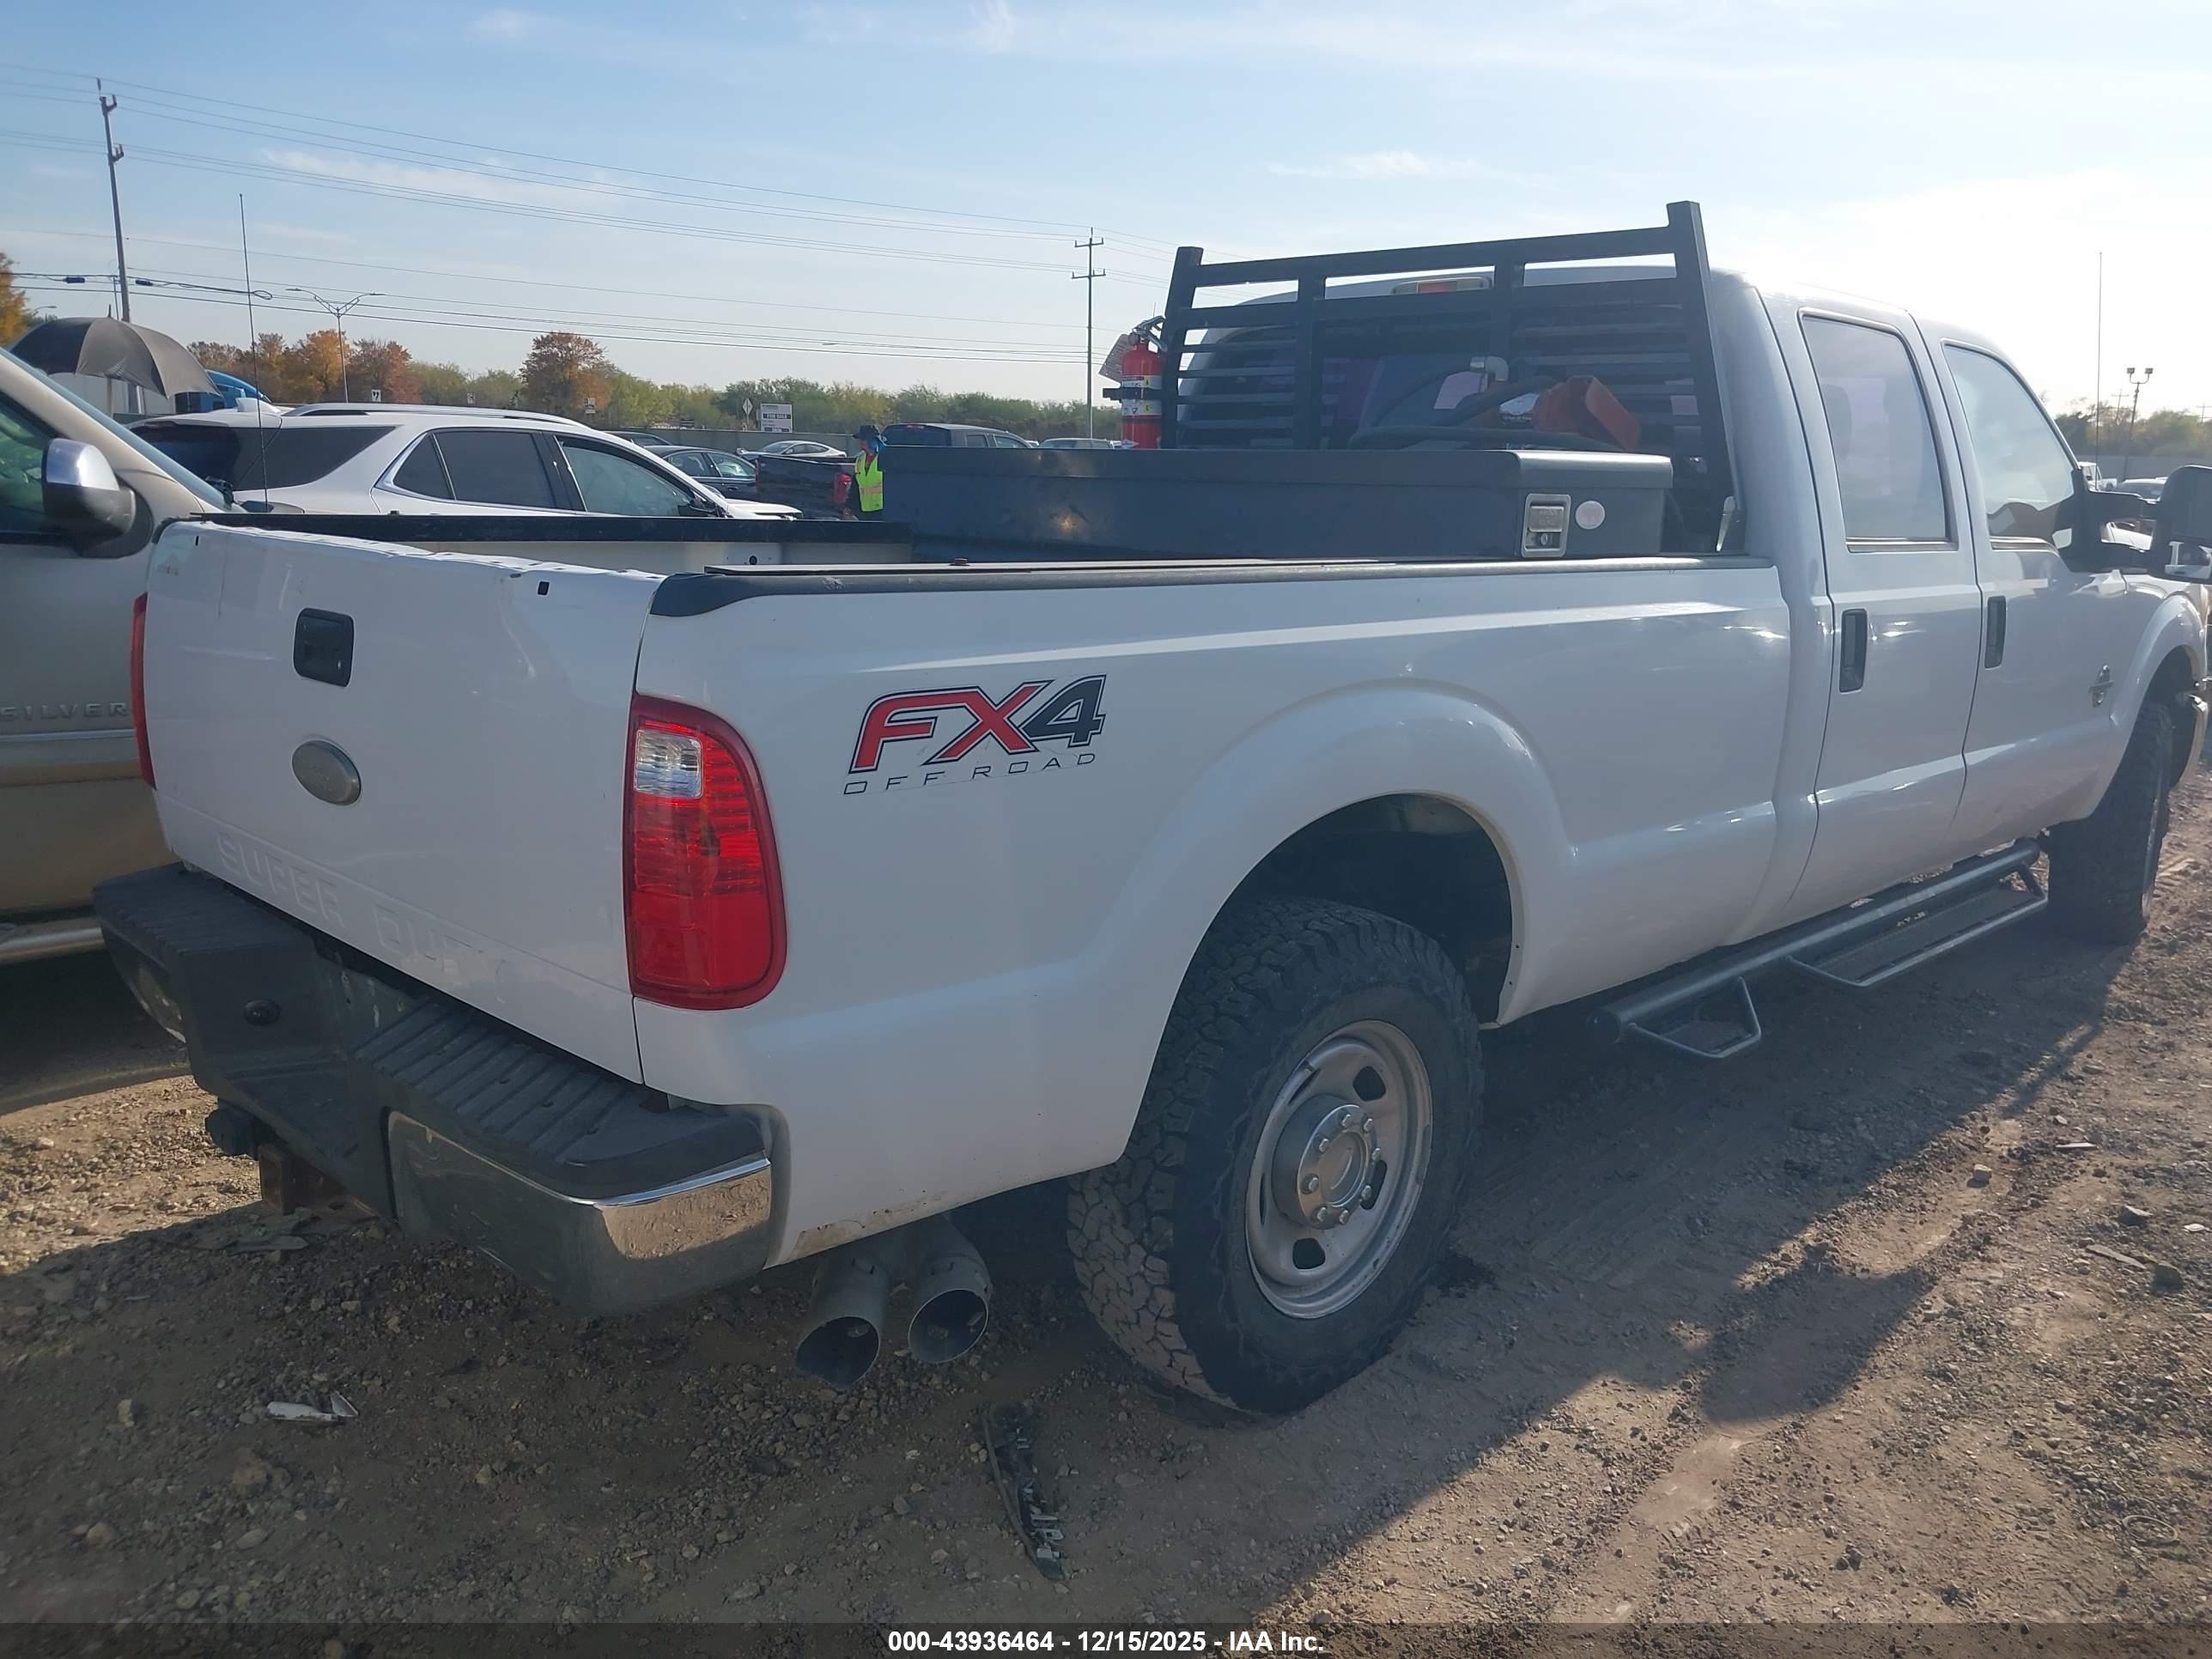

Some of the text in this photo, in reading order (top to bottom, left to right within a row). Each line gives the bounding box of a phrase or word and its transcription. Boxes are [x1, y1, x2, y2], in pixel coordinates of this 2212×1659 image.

[848, 674, 1106, 774] FX4
[843, 753, 1097, 795] OFF ROAD
[216, 831, 345, 927] SUPER
